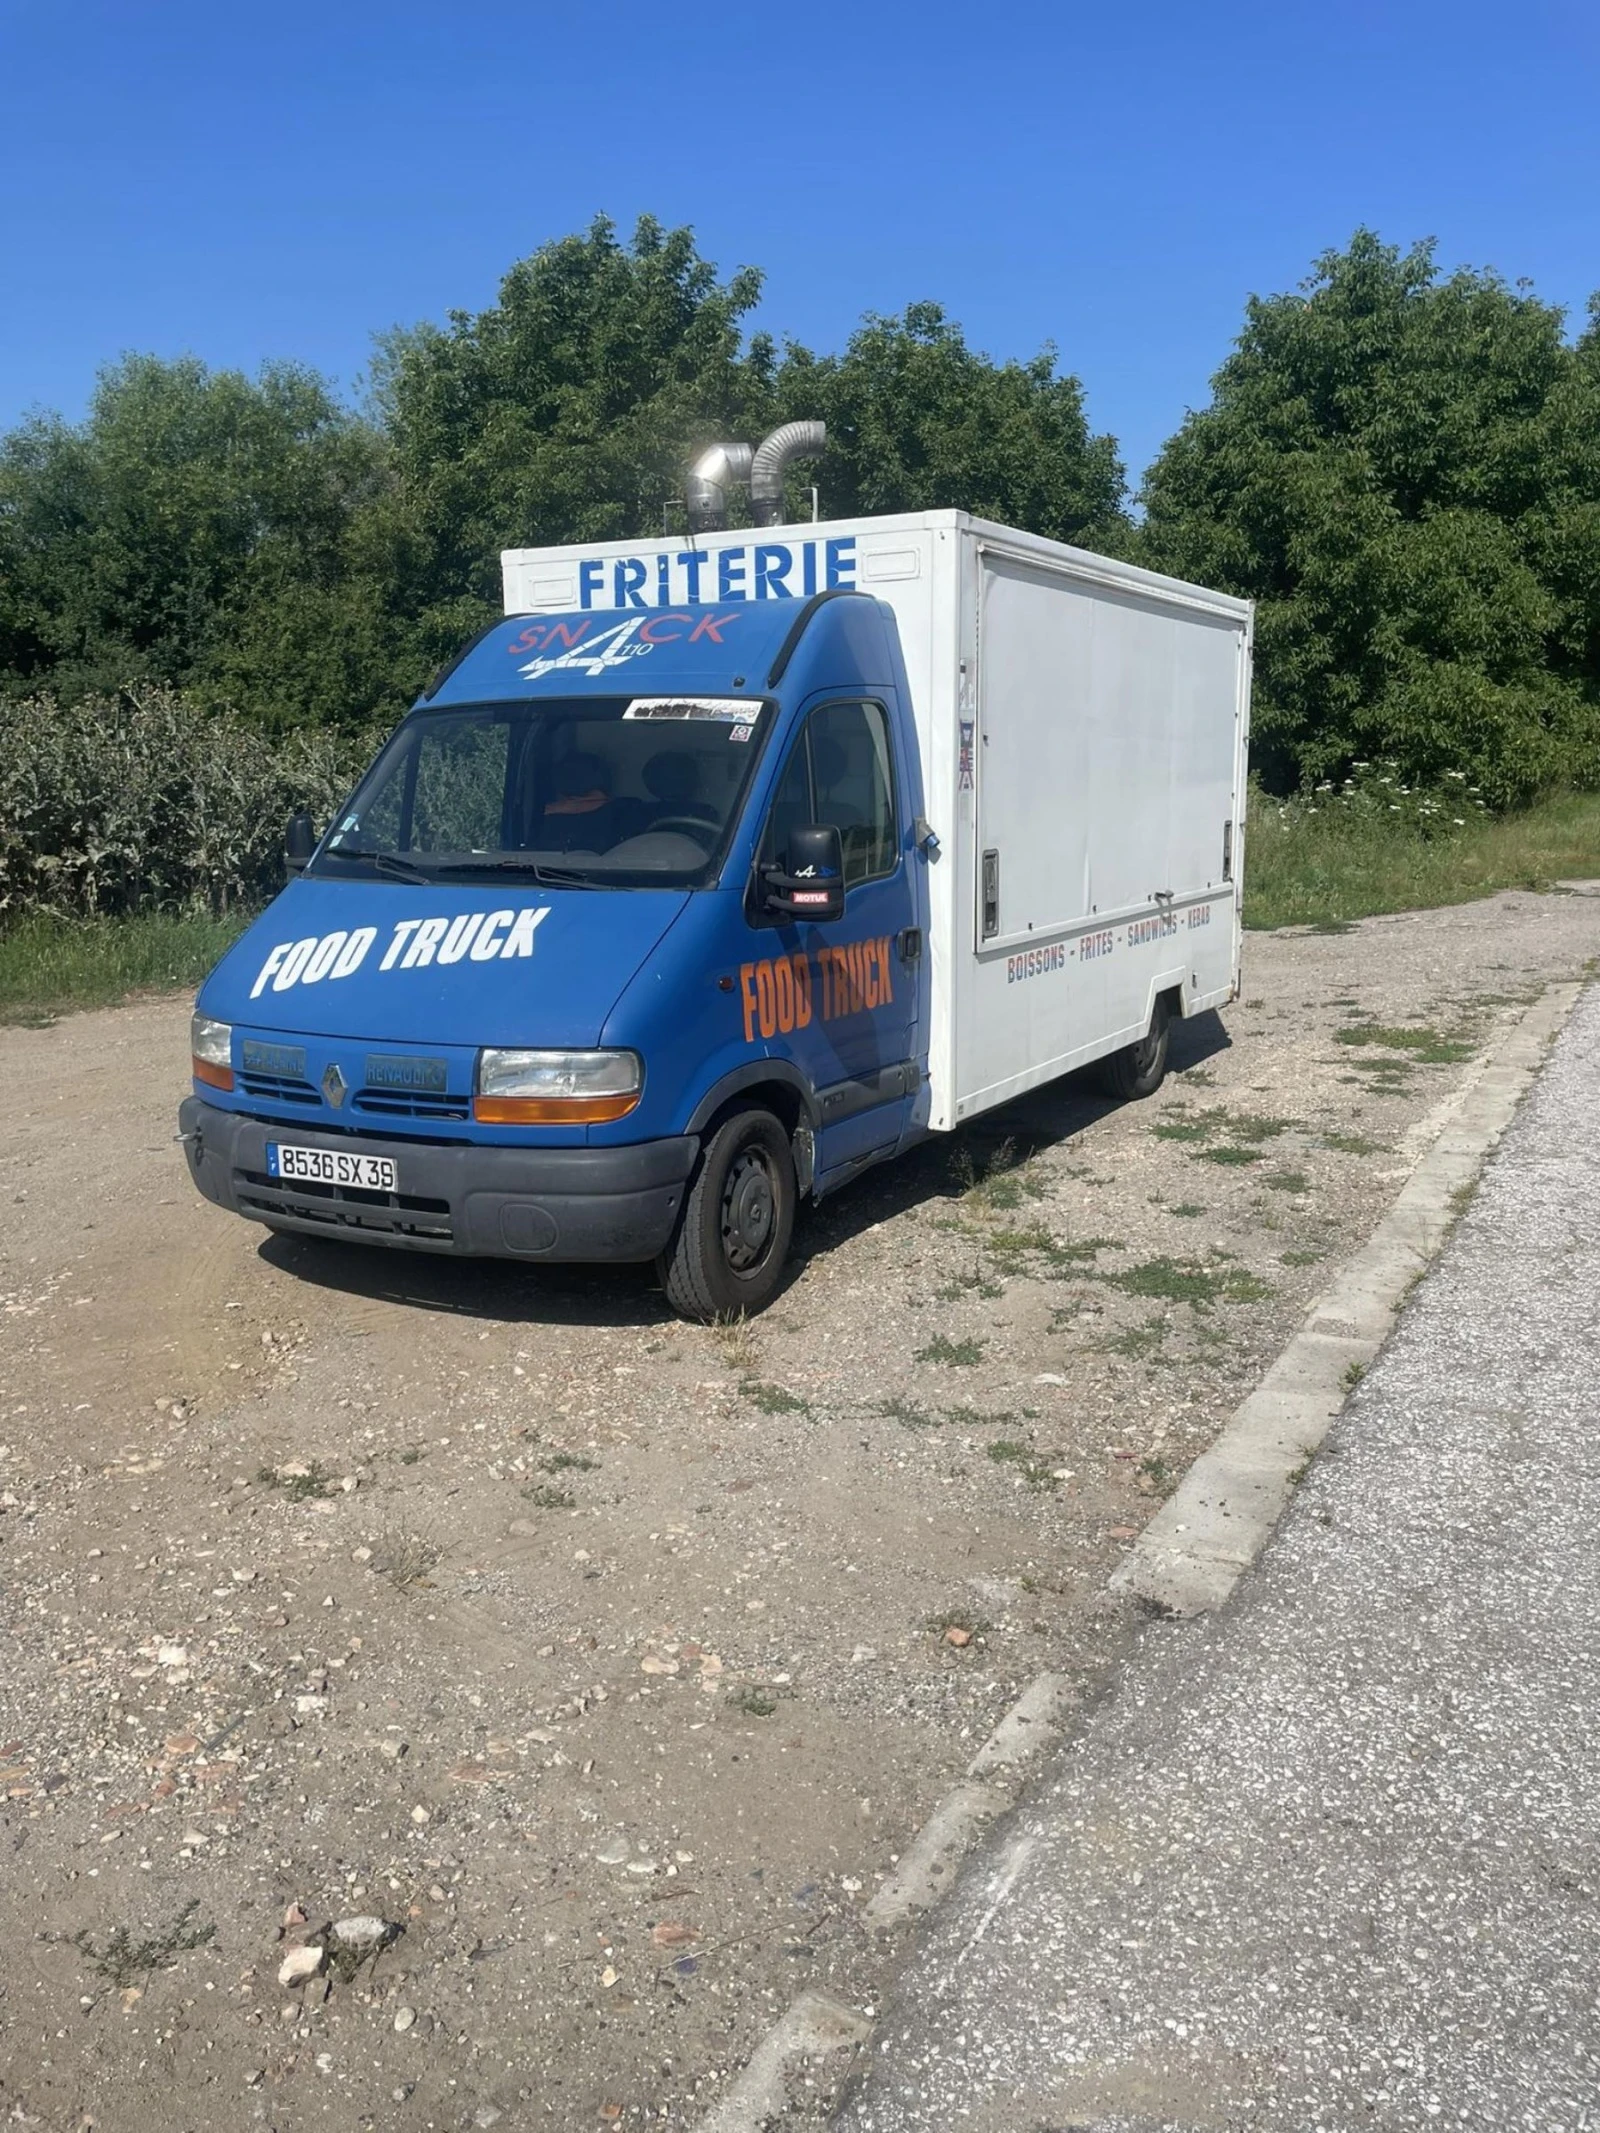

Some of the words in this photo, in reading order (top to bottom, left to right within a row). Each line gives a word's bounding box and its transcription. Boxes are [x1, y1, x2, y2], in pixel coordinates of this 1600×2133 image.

[580, 537, 856, 609] FRITERIE
[621, 643, 654, 656] 110
[794, 892, 829, 903] MOTUL
[249, 926, 377, 999] FOOD
[379, 907, 552, 971] TRUCK
[1007, 945, 1065, 984] BOISSONS
[1080, 931, 1114, 962] FRITES
[1187, 905, 1211, 930] KEBAB
[740, 953, 812, 1042] FOOD
[817, 936, 893, 1021] TRUCK
[282, 1149, 334, 1180] 8536
[338, 1156, 363, 1184] SX
[366, 1160, 394, 1188] 39
